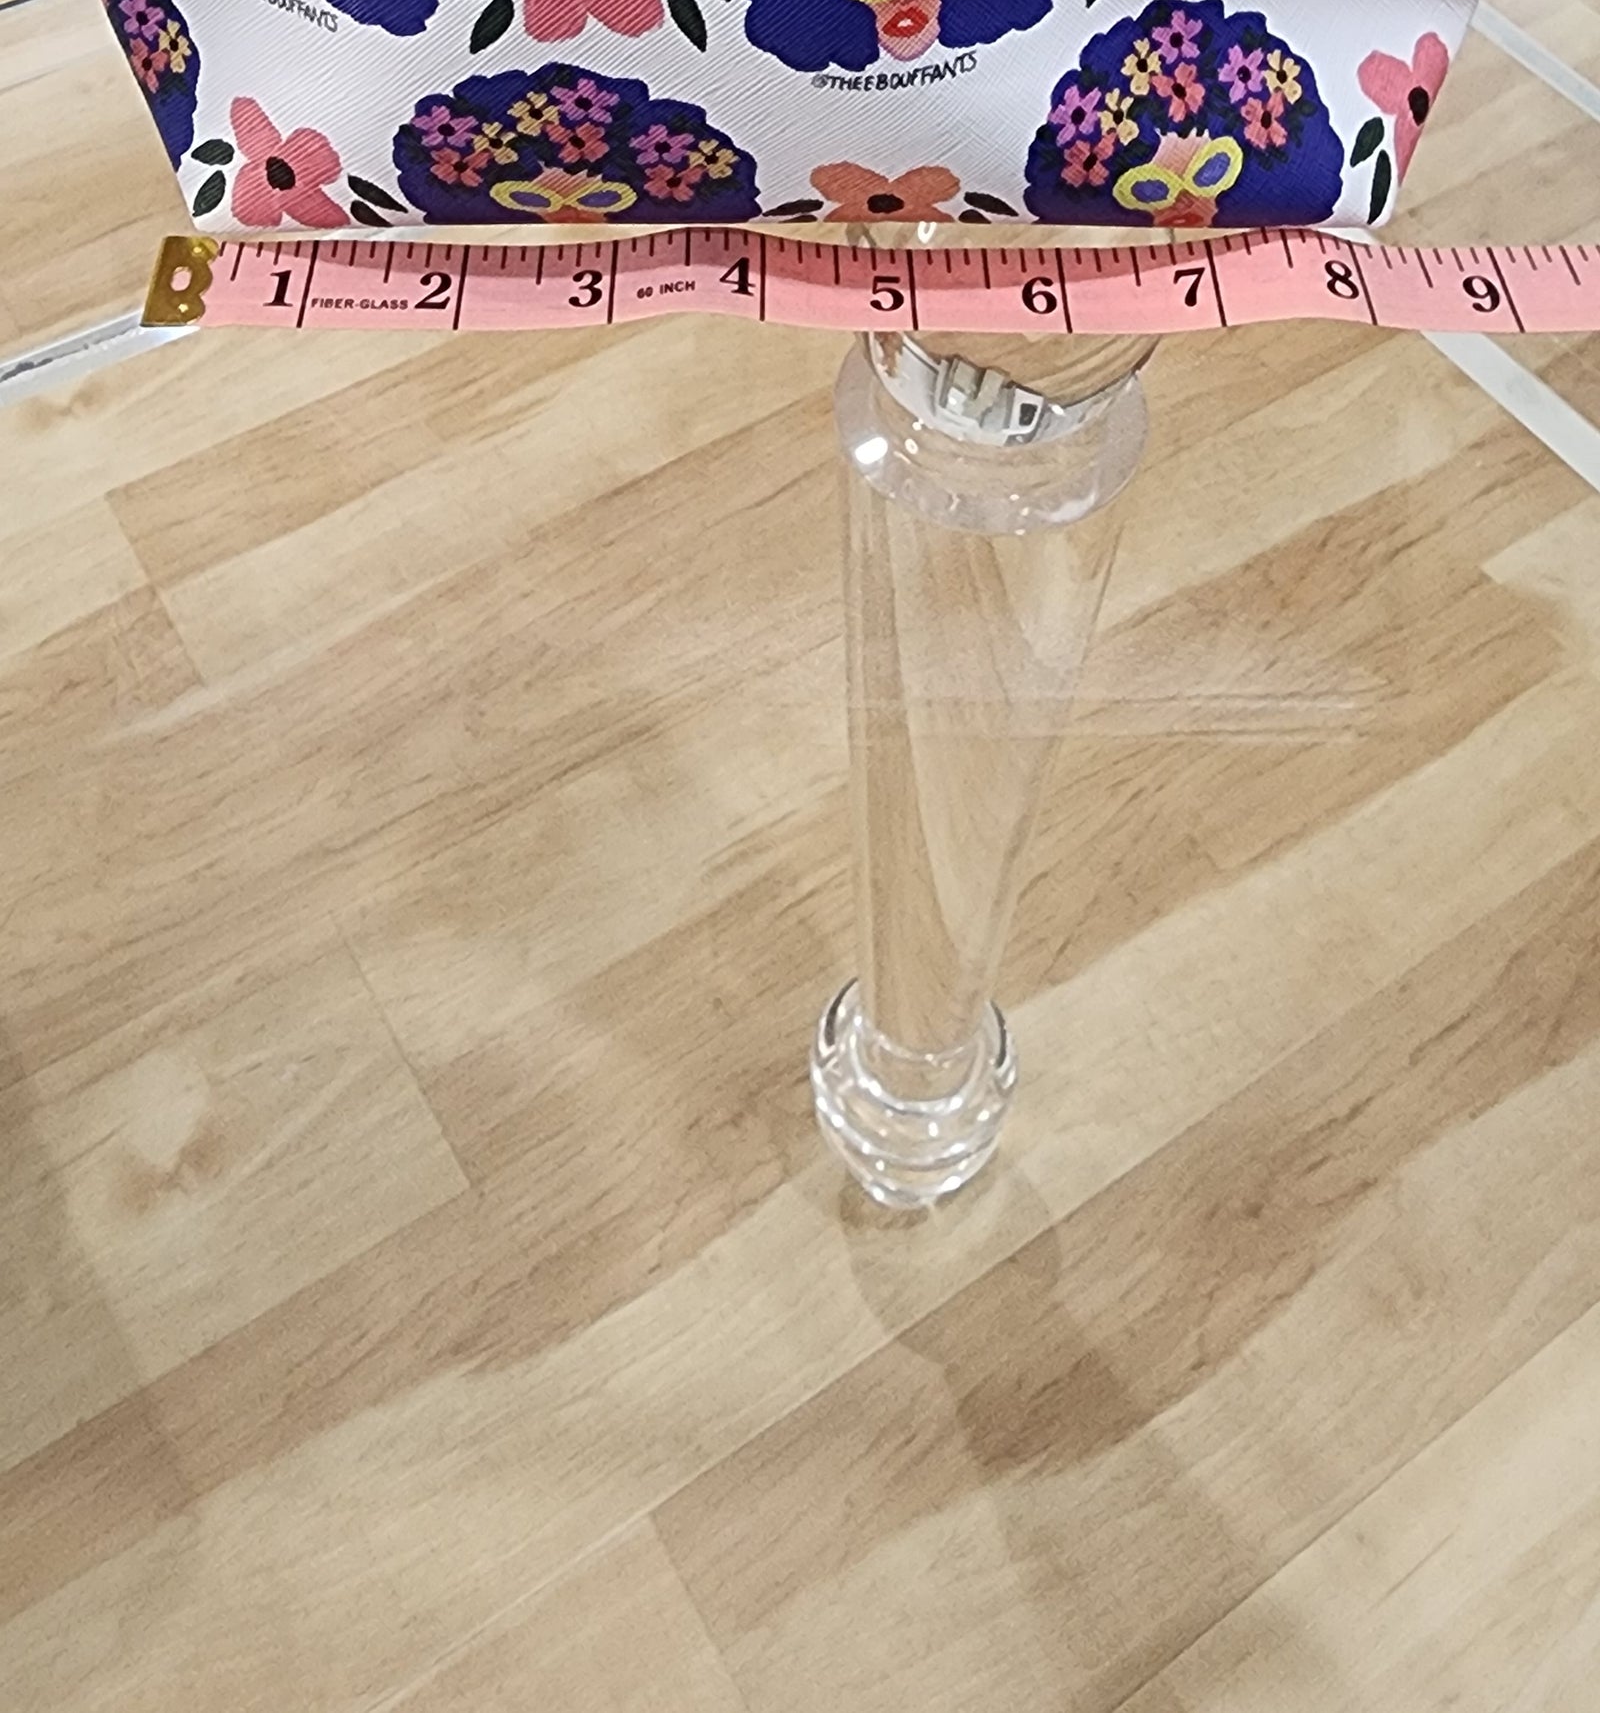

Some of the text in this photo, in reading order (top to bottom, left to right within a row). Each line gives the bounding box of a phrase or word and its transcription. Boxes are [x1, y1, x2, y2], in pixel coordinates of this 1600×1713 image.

[263, 256, 1501, 314] 1 FIBER-GLASS 2 3 60 INCH 4 5 6 7 8 9
